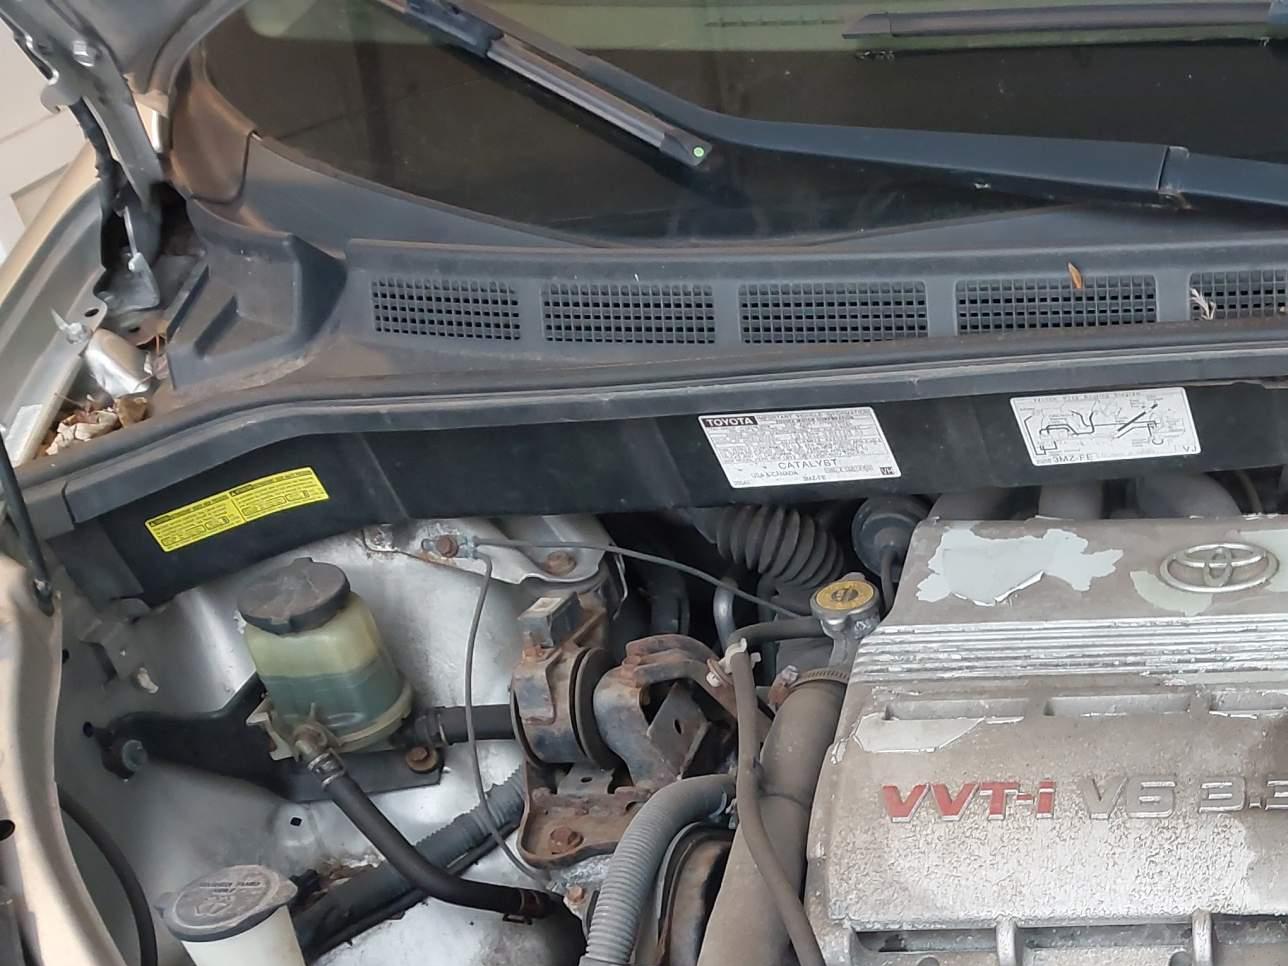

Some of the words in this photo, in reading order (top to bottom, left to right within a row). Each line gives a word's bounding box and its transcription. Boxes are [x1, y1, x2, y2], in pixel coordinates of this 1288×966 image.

[706, 417, 753, 426] TOYOTA
[881, 777, 1056, 824] VVT-i
[1078, 773, 1176, 820] V6
